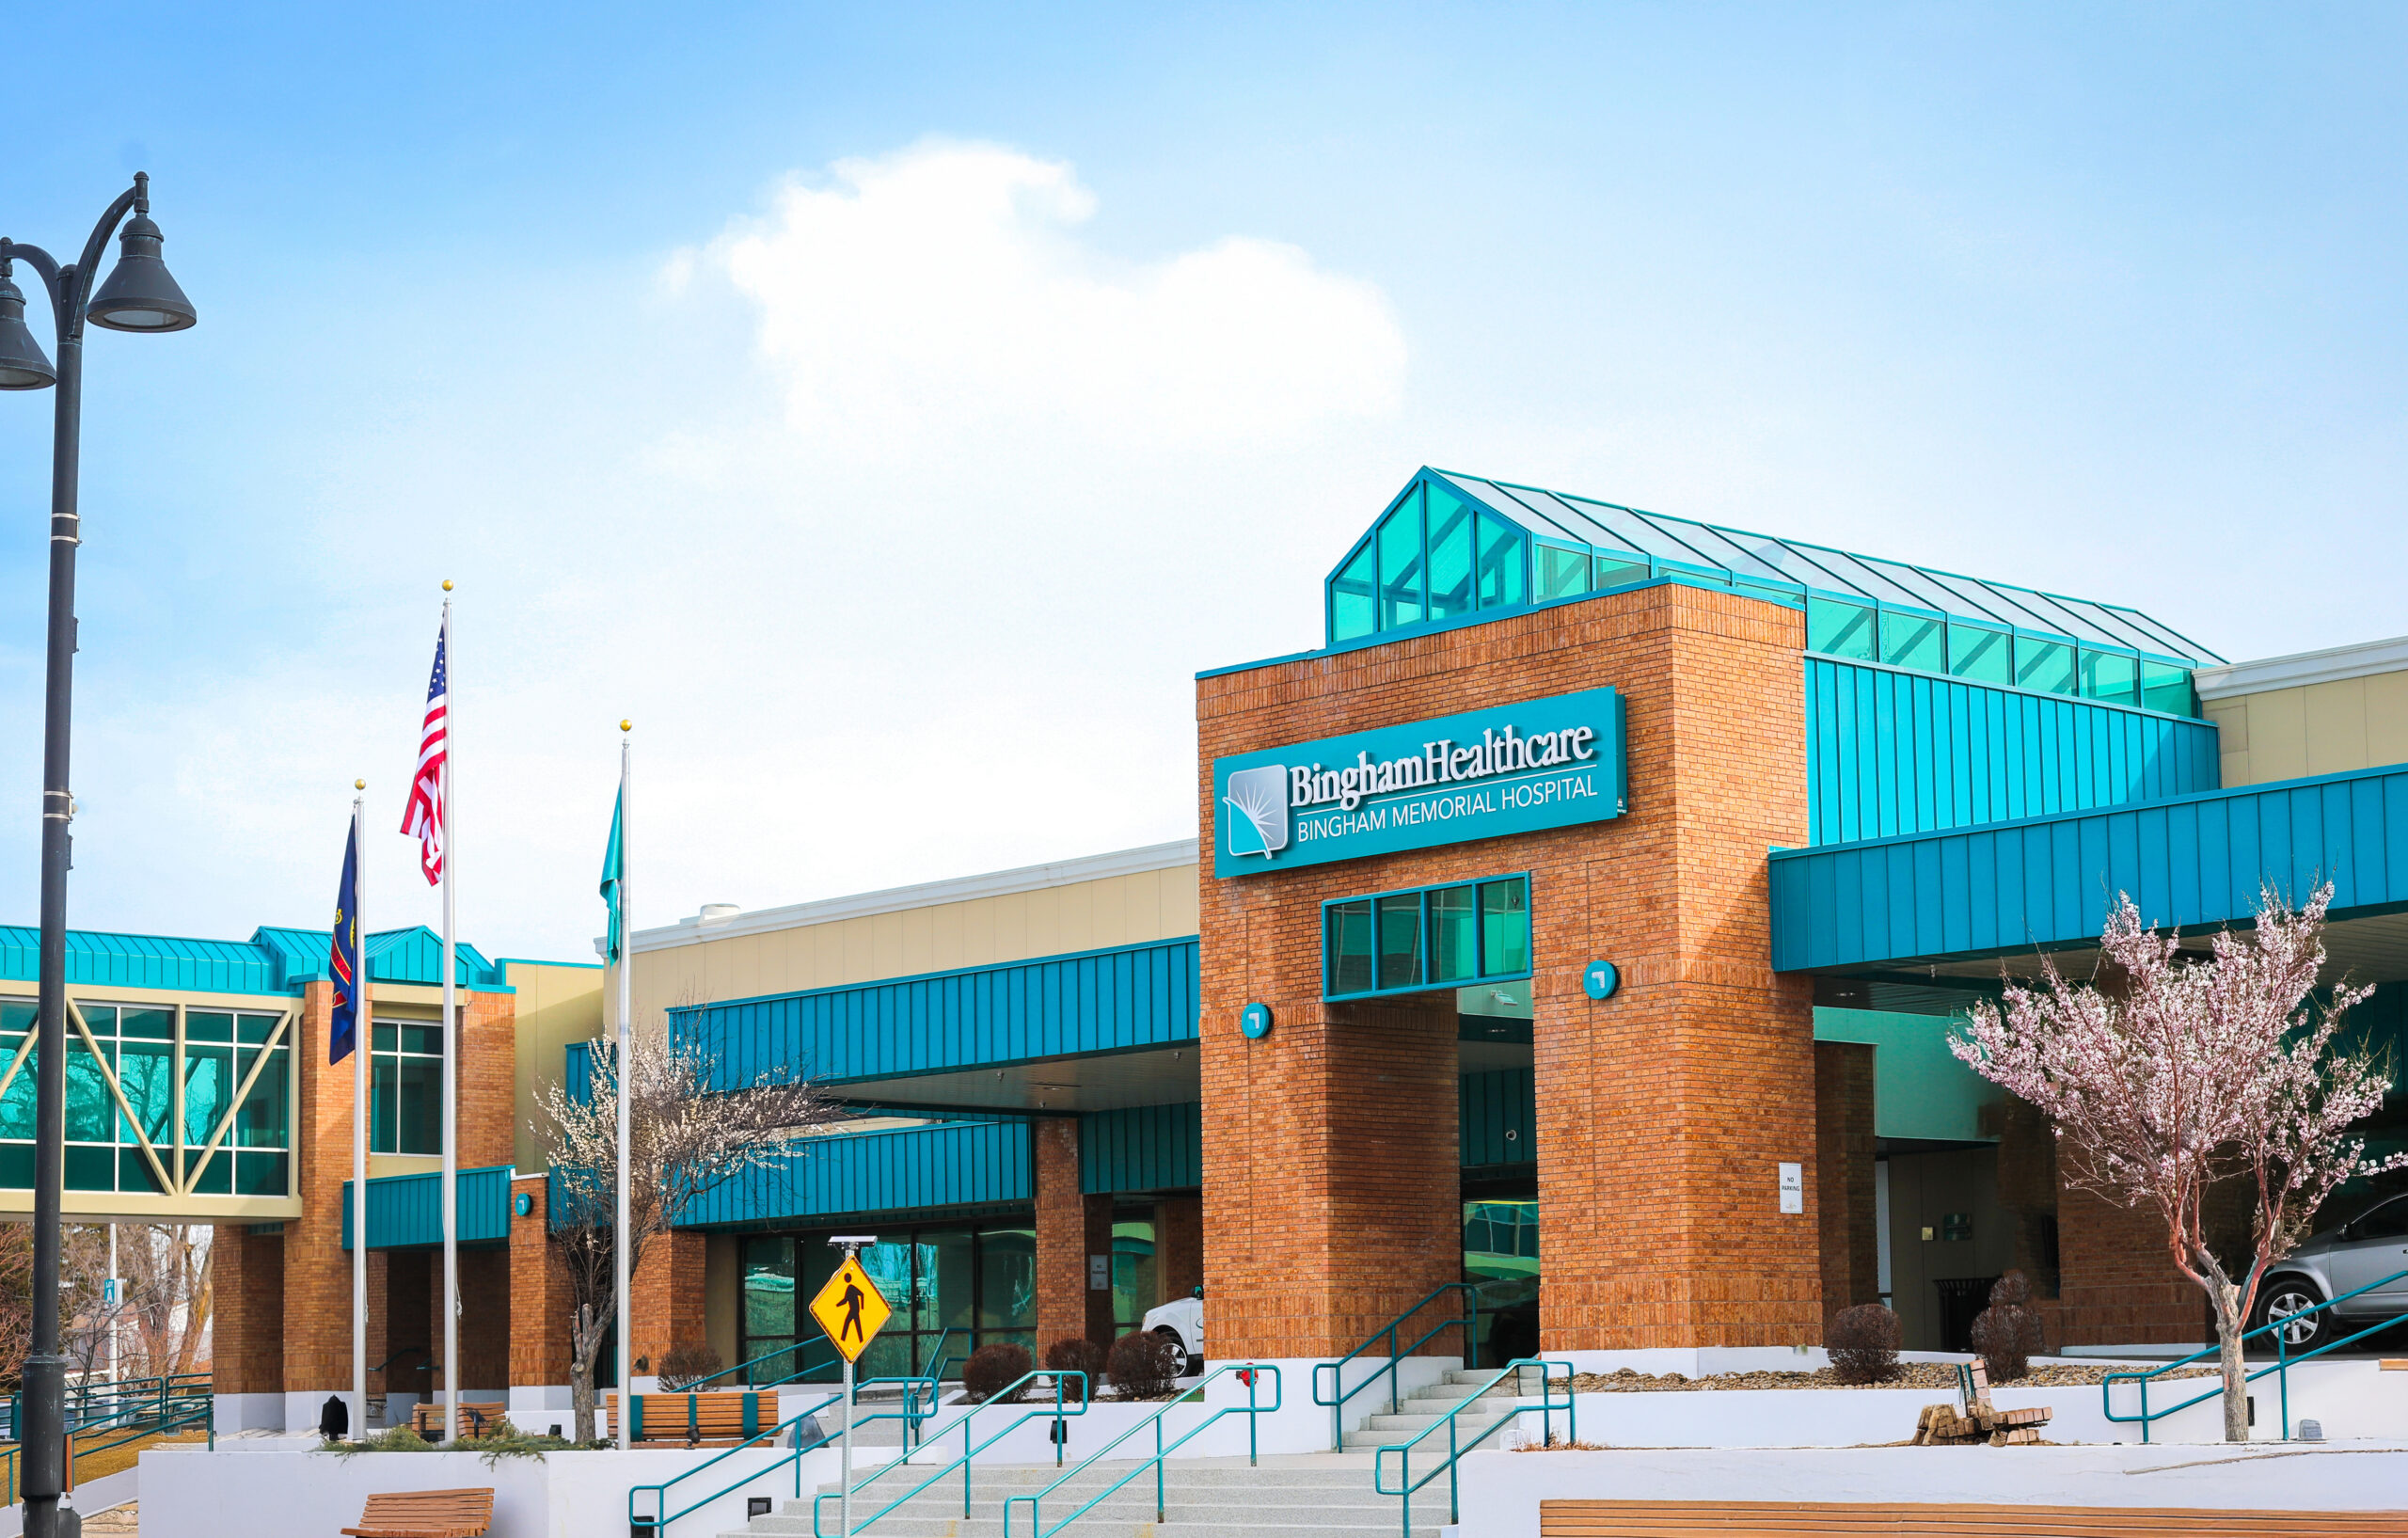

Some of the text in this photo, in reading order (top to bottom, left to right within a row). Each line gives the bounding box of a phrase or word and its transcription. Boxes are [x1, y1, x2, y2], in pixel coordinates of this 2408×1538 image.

[1290, 724, 1593, 811] BinghamHealthcare
[1298, 808, 1386, 842] BINGHAM
[1392, 791, 1497, 828] MEMORIAL
[1501, 774, 1598, 810] HOSPITAL
[106, 1289, 113, 1303] A
